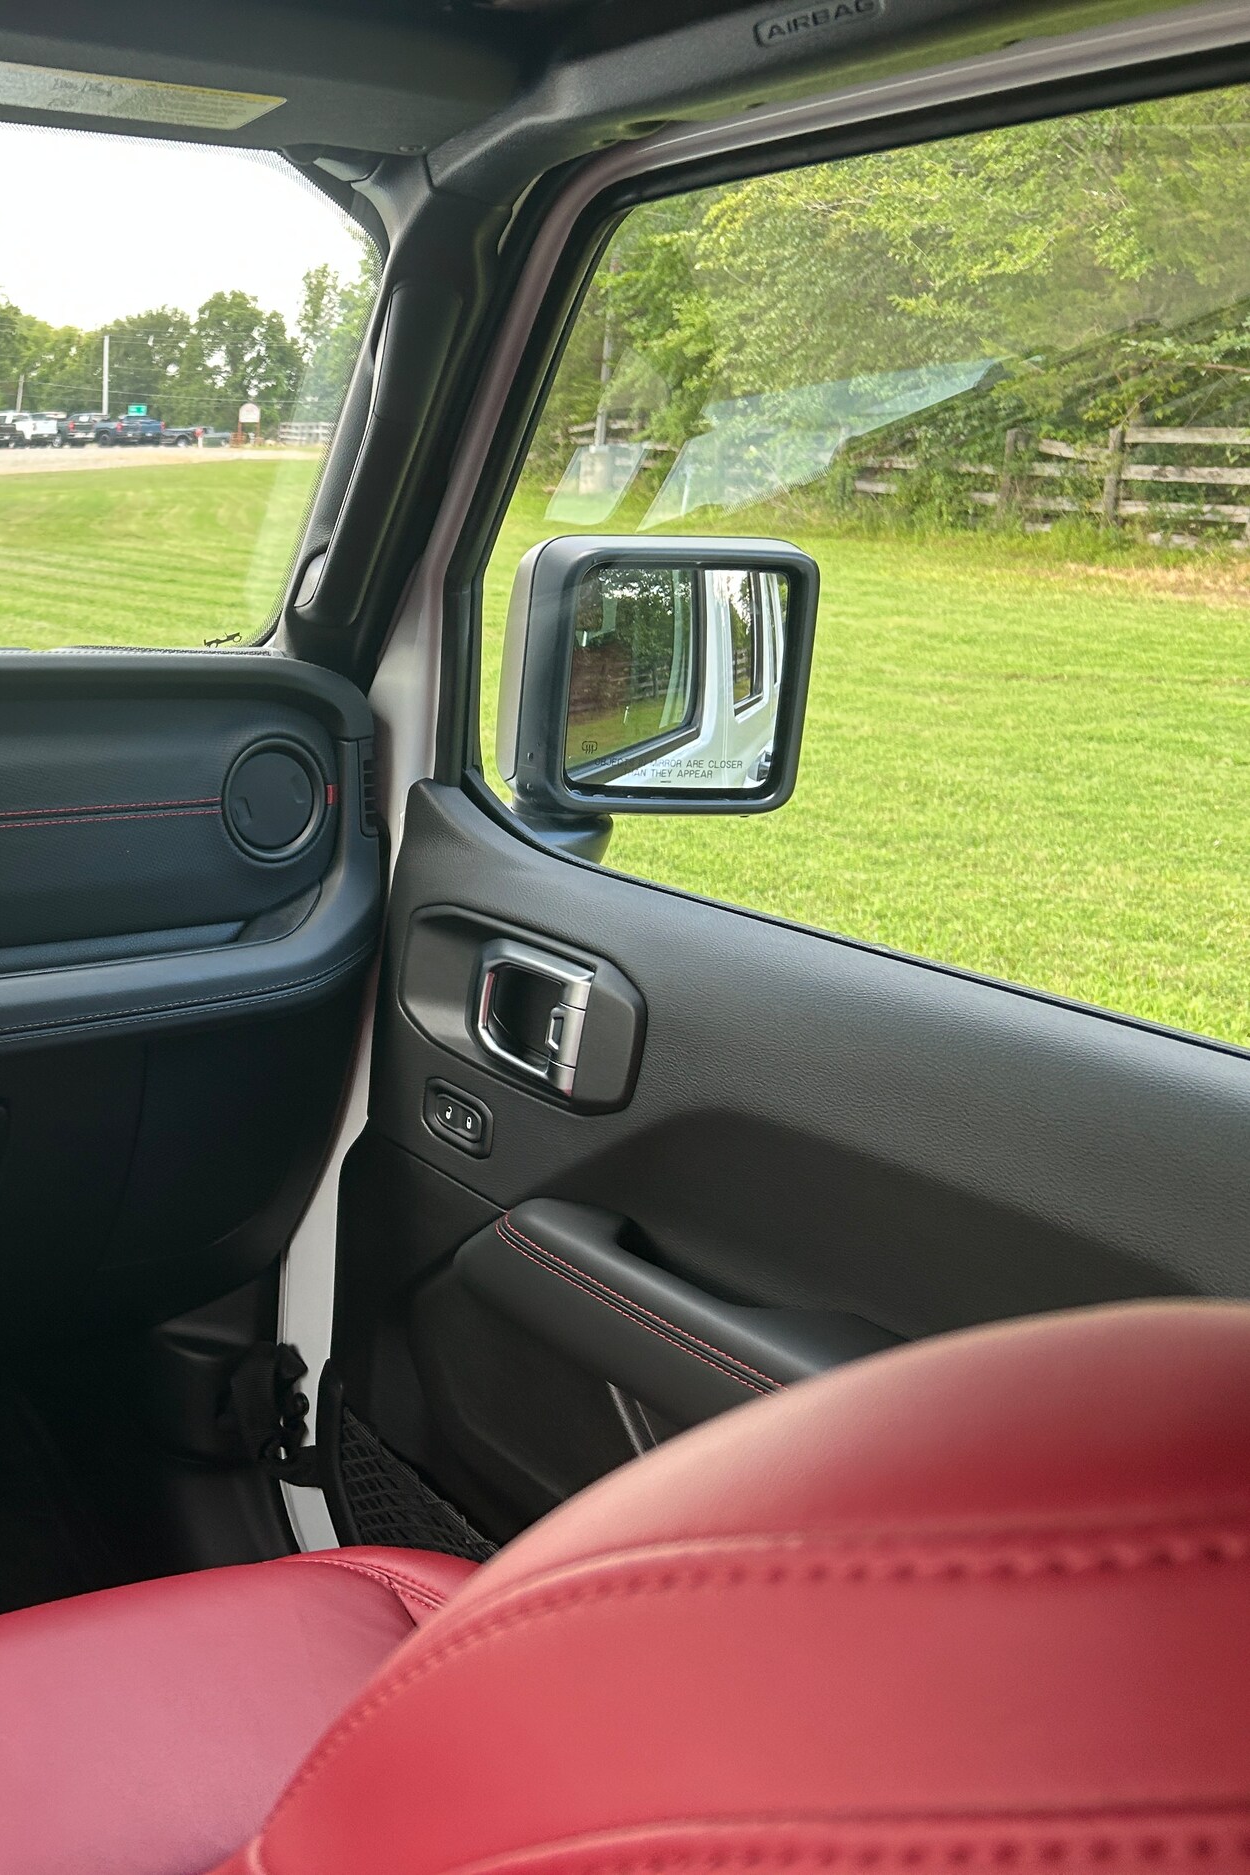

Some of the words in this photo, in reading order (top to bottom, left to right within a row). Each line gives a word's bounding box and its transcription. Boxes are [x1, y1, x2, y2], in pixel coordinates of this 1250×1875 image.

[767, 0, 876, 40] AIRBAG
[685, 760, 705, 769] ARE
[708, 760, 744, 769] CLOSER
[650, 769, 673, 778] THEY
[676, 770, 714, 779] APPEAR
